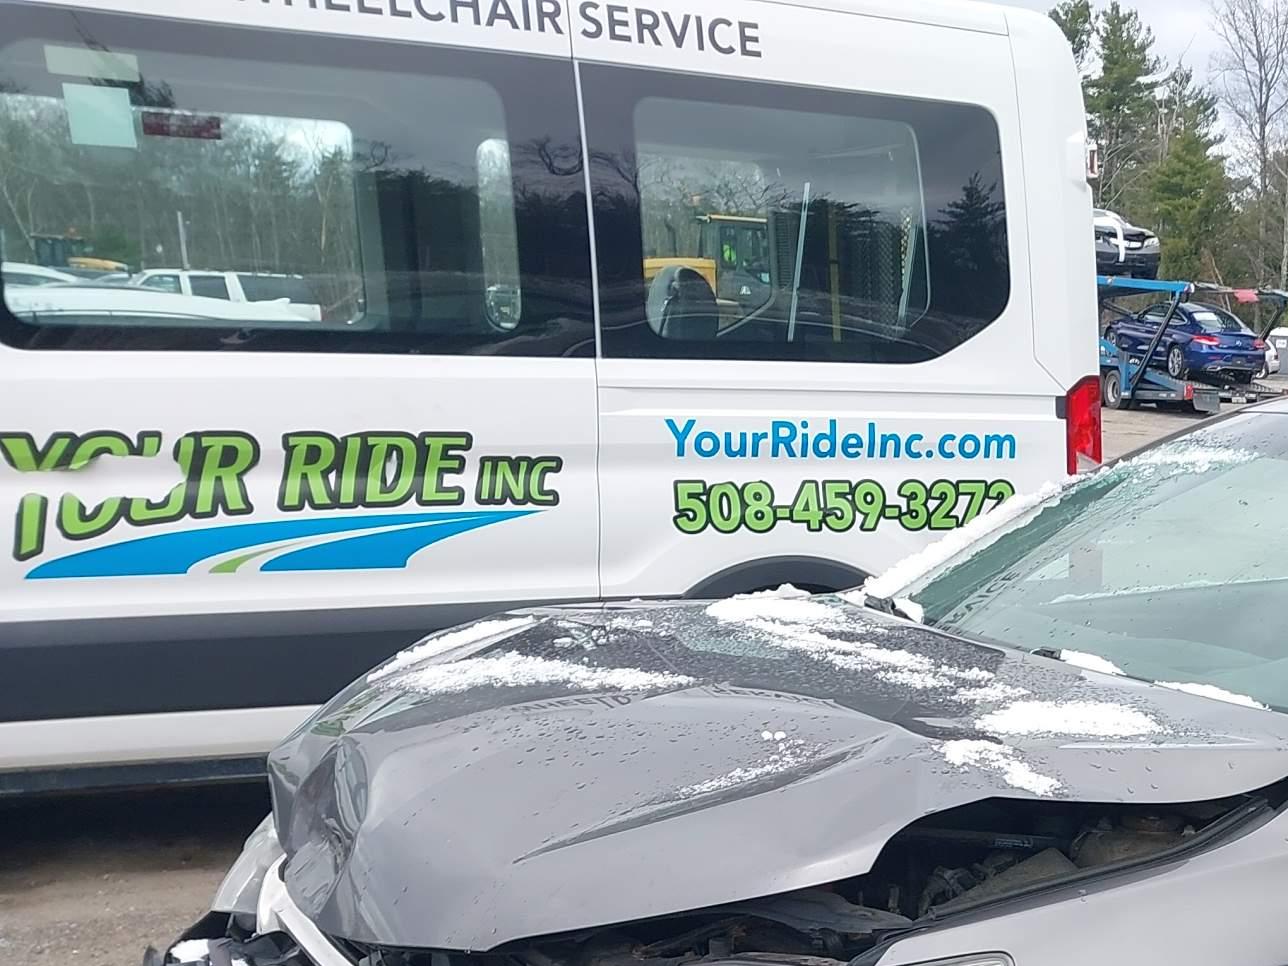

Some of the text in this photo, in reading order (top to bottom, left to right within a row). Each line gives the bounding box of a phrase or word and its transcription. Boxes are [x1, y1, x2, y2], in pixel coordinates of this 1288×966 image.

[236, 0, 762, 58] CHAIR SERVICE
[665, 419, 1016, 459] YourRideInc.com
[0, 430, 563, 561] YOUR RIDE INC
